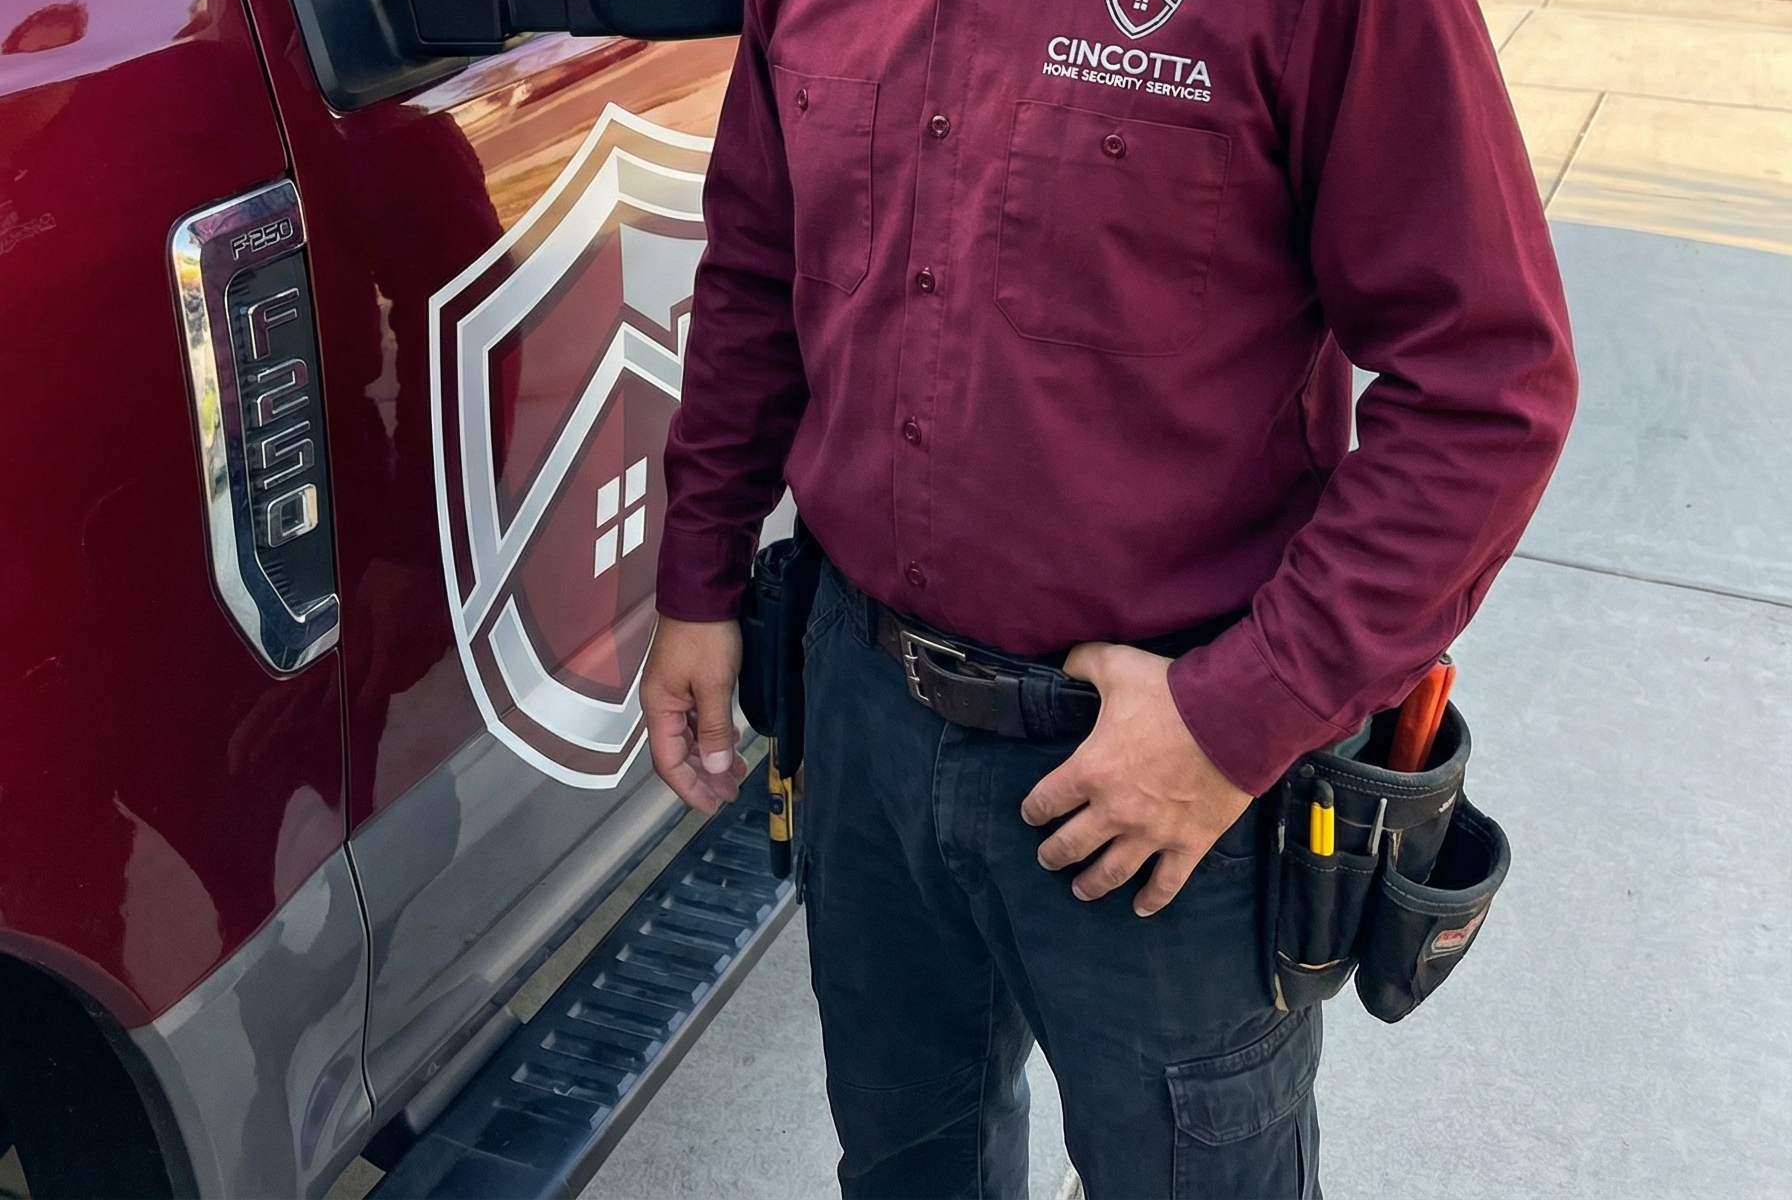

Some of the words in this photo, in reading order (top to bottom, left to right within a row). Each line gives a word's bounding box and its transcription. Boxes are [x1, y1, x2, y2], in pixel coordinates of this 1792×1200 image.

[1043, 63, 1078, 79] HOME
[1082, 69, 1143, 90] SECURITY
[1146, 82, 1211, 102] SERVICES
[1048, 37, 1211, 87] CINCOTTA
[231, 217, 293, 261] F-250
